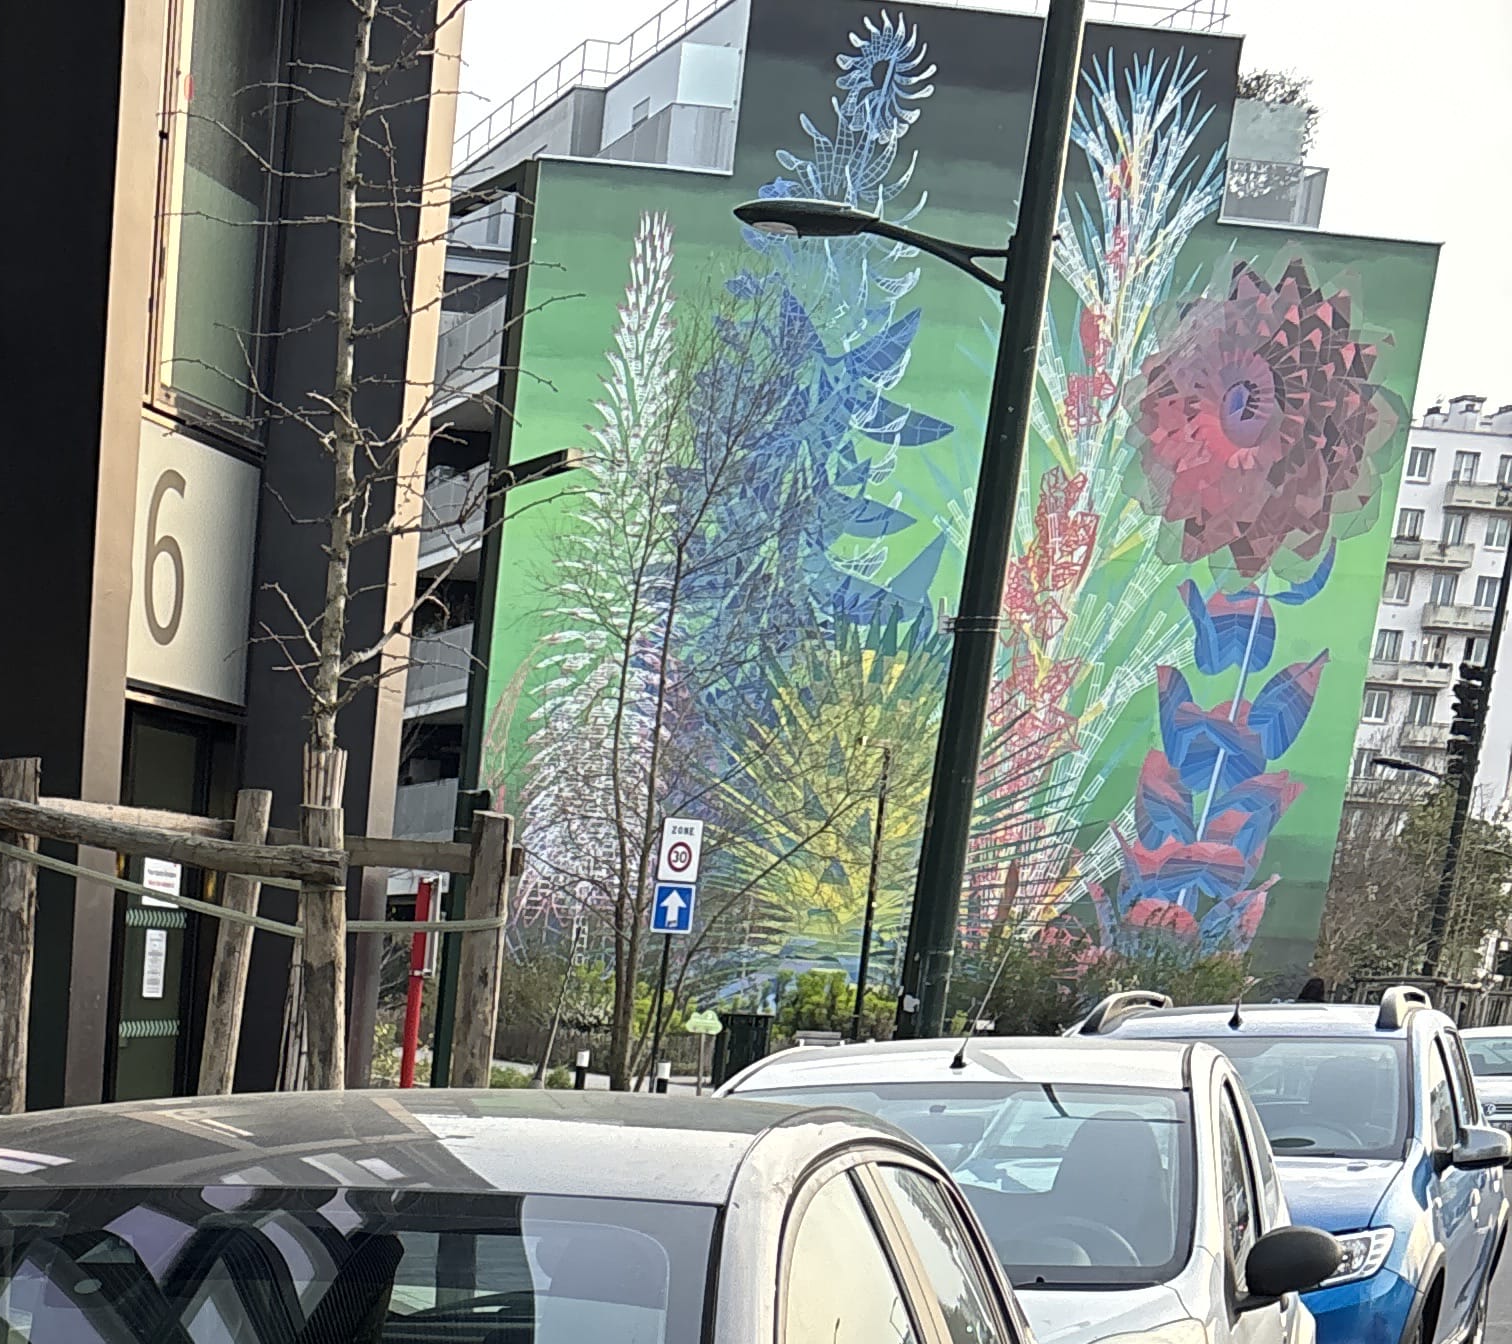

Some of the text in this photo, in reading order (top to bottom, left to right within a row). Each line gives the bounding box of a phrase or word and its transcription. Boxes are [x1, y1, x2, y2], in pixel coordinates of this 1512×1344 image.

[142, 468, 188, 647] 6
[672, 826, 695, 836] ZONE
[673, 851, 688, 864] 30
